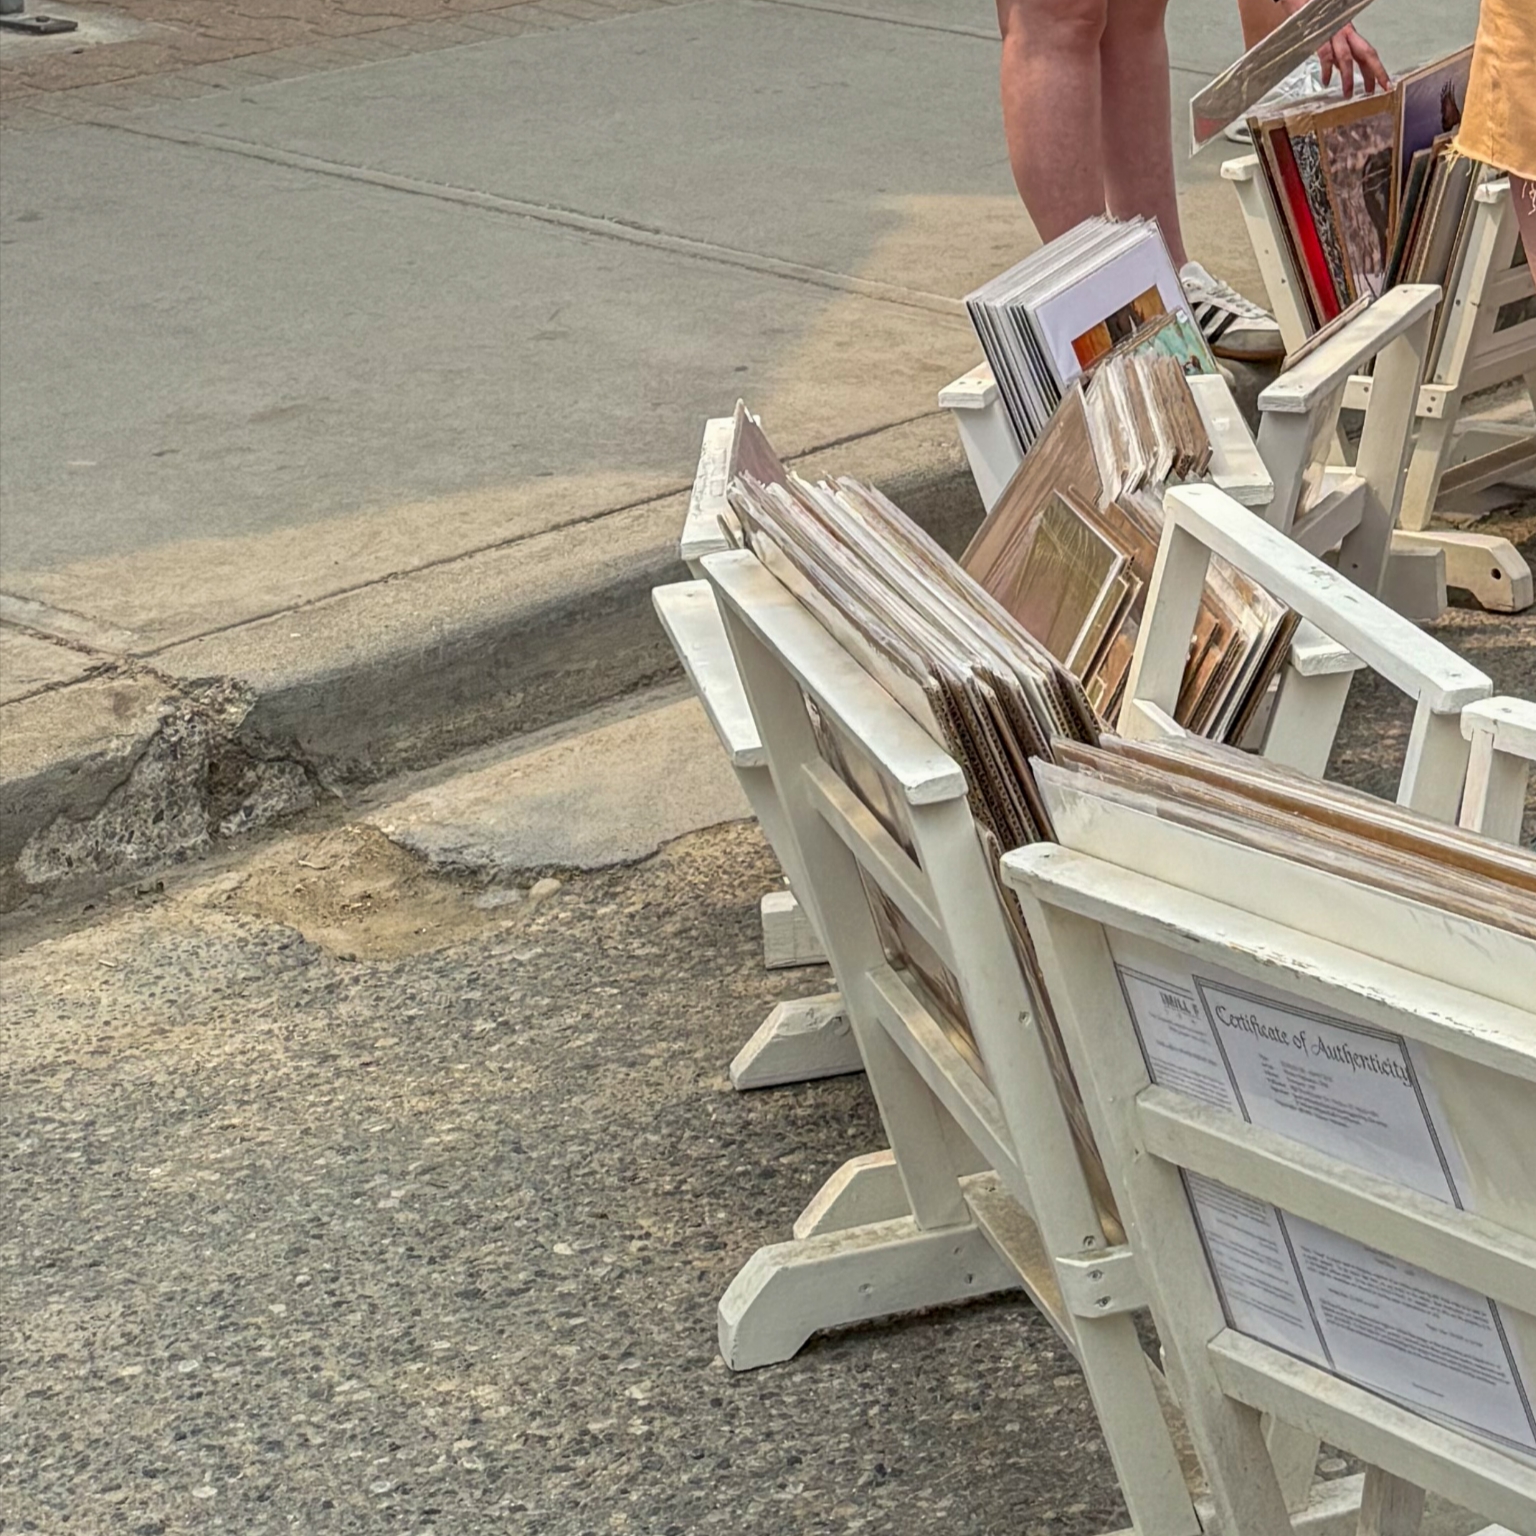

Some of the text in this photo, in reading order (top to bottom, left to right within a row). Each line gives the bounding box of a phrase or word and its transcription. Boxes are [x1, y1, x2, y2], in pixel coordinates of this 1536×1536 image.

[1215, 1004, 1290, 1046] Certificate
[1292, 1030, 1309, 1057] of
[1311, 1036, 1412, 1087] Authenticity
